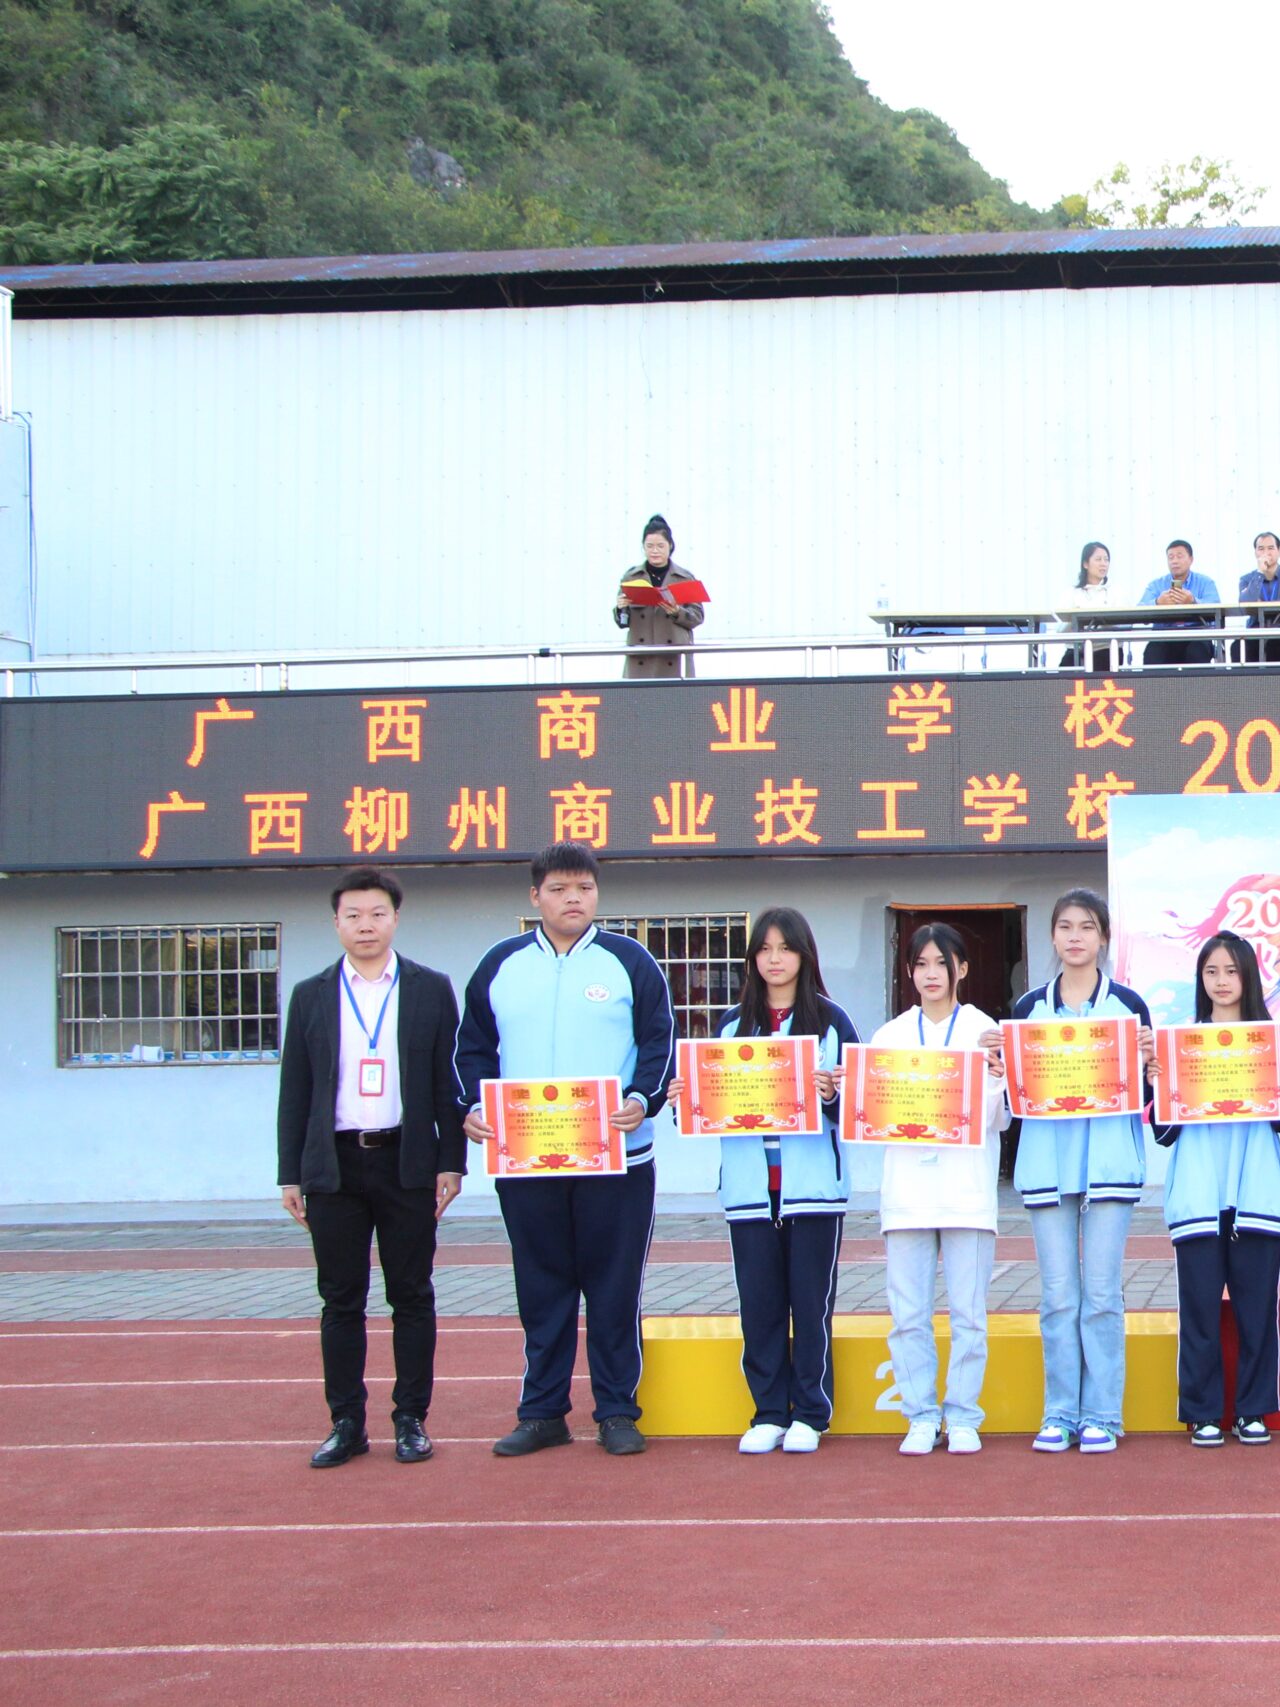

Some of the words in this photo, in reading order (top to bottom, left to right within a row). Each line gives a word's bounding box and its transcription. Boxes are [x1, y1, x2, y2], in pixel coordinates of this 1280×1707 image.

[187, 680, 1134, 768] 广西商业学校
[139, 771, 1136, 859] 广西柳州商业技工学校
[875, 1360, 903, 1411] 2
